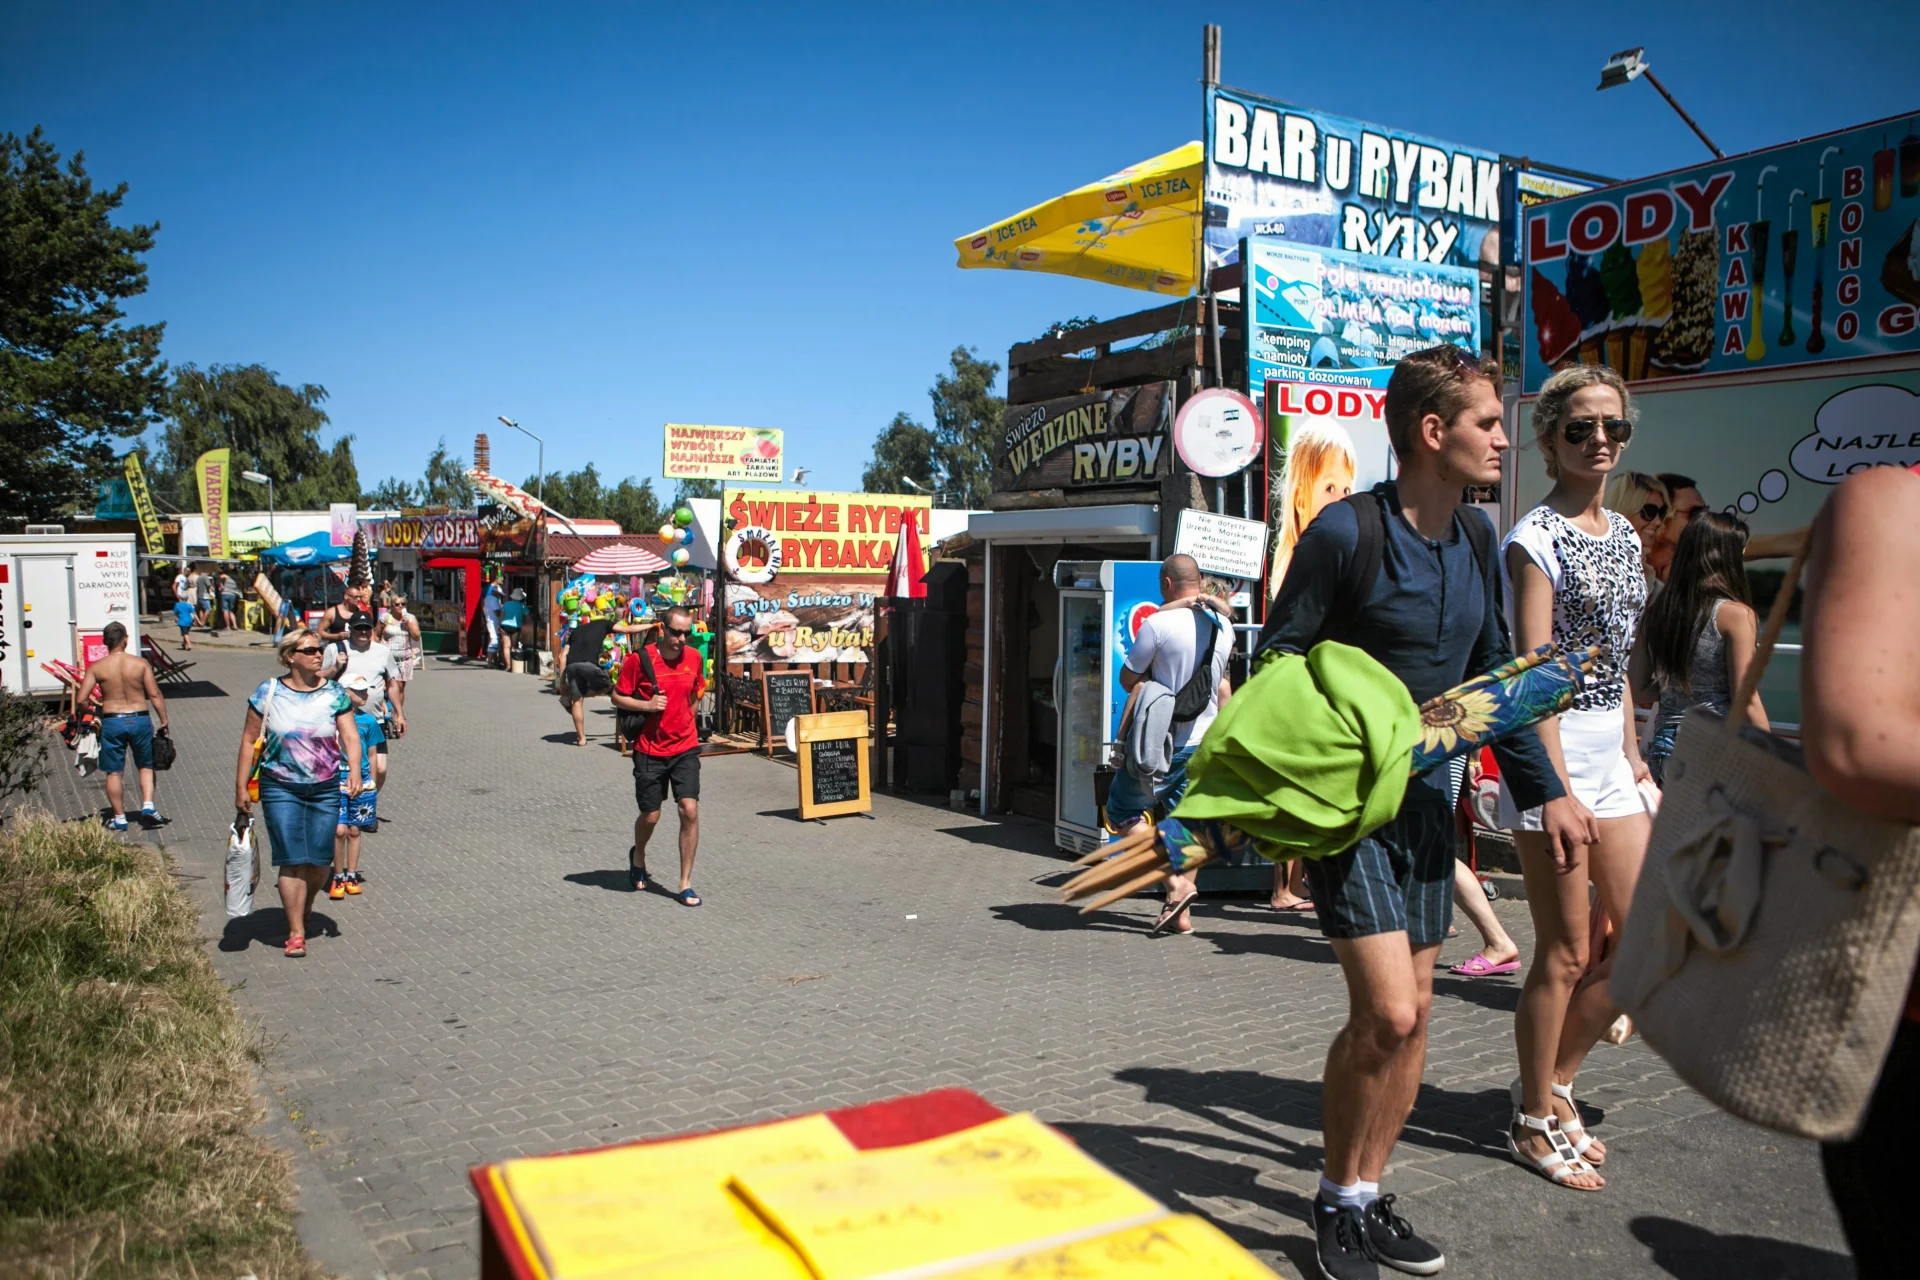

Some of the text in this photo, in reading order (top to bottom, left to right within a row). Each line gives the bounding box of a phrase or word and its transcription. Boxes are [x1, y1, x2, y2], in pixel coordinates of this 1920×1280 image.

[1214, 96, 1317, 184] BAR
[1359, 131, 1499, 222] RYBAK
[1139, 177, 1191, 199] ICE TEA
[996, 216, 1037, 242] ICE TEA
[1529, 171, 1736, 264] LODY
[1343, 203, 1459, 264] RYBY
[1836, 165, 1864, 342] BONGO
[1316, 262, 1471, 305] Pole namiotowe
[1722, 222, 1750, 355] KAWA
[1315, 299, 1472, 335] OLIMPIA nad morzem
[1263, 332, 1310, 350] kemping
[1264, 350, 1307, 367] namioty
[1264, 367, 1372, 387] parking dozorowany
[1278, 383, 1387, 421] LODY
[1005, 405, 1046, 448] świeżo
[1008, 403, 1108, 476] WĘDZONE
[671, 439, 715, 451] WYBÓR
[1073, 435, 1164, 480] RYBY
[670, 464, 700, 473] CENY
[1826, 461, 1920, 478] LO
[205, 464, 223, 556] WARKOCZYKI
[729, 492, 839, 532] ŚWIEŻE
[1199, 516, 1246, 531] Nie dotyczy
[384, 519, 422, 547] LODY
[1219, 528, 1257, 541] Morskiego
[95, 561, 129, 569] GAZETĘ
[737, 530, 780, 576] SMAZALNIA
[781, 539, 894, 568] RYBAKA
[1210, 554, 1258, 568] komunalnych
[1202, 563, 1251, 576] zaopatrzenia
[79, 581, 130, 590] DARMOWĄ
[103, 591, 130, 599] KAWĘ
[733, 597, 781, 617] Ryby
[786, 589, 852, 608] Świeżo
[768, 631, 785, 647] u
